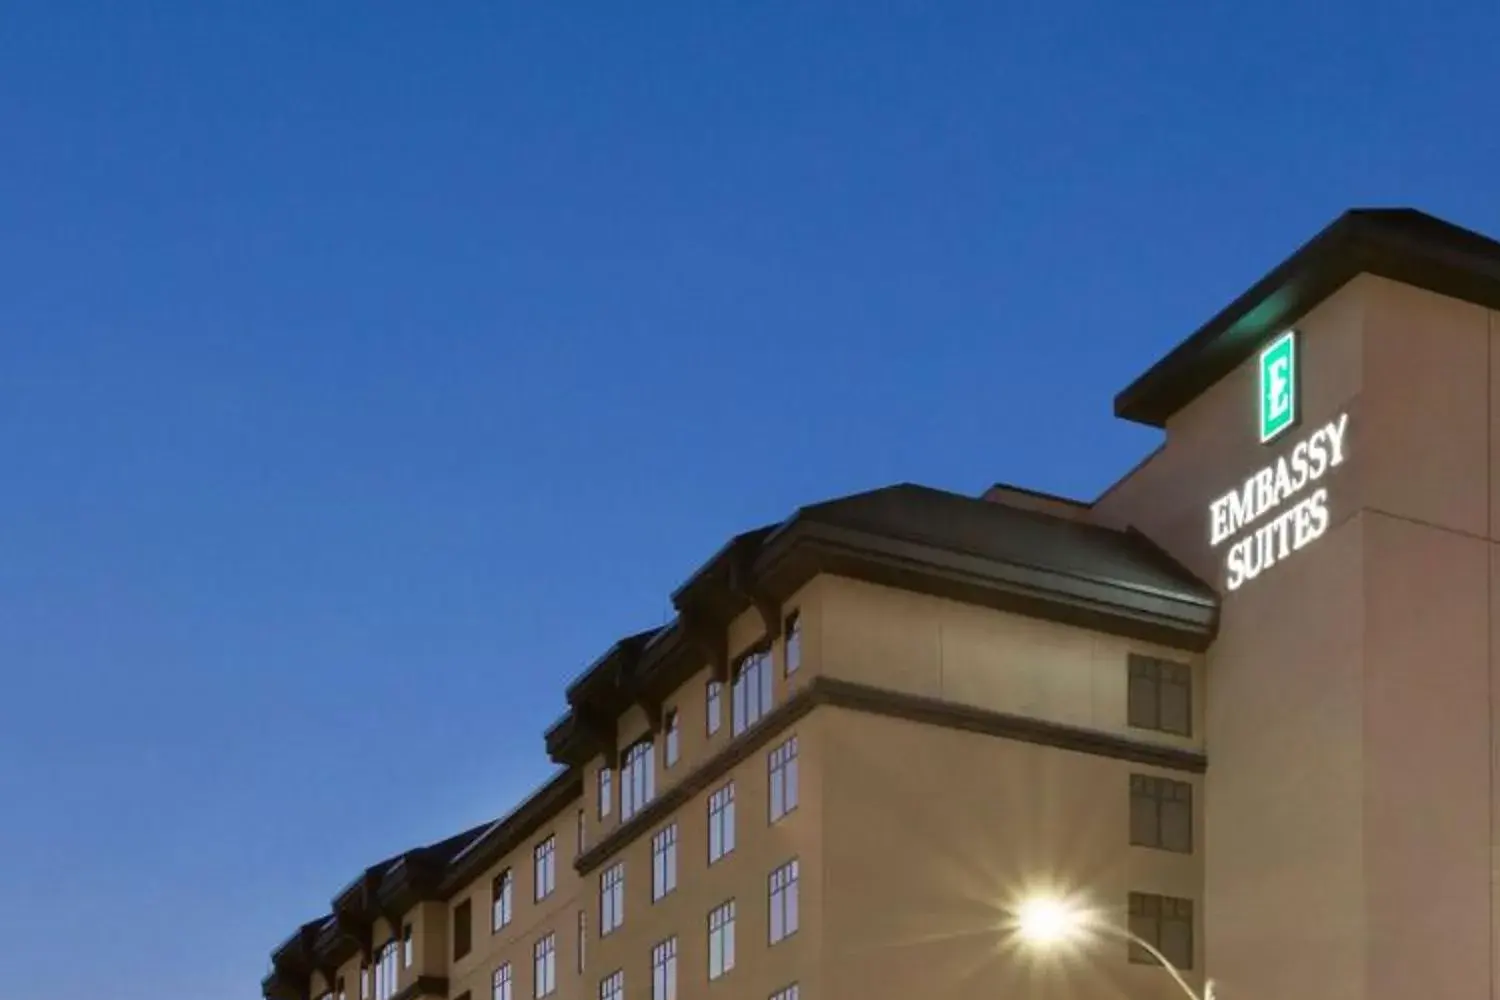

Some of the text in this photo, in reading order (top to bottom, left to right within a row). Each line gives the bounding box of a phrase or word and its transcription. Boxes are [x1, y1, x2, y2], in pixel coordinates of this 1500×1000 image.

[1268, 357, 1288, 420] E
[1209, 413, 1348, 546] EMBASSY
[1226, 489, 1329, 590] SUITES
